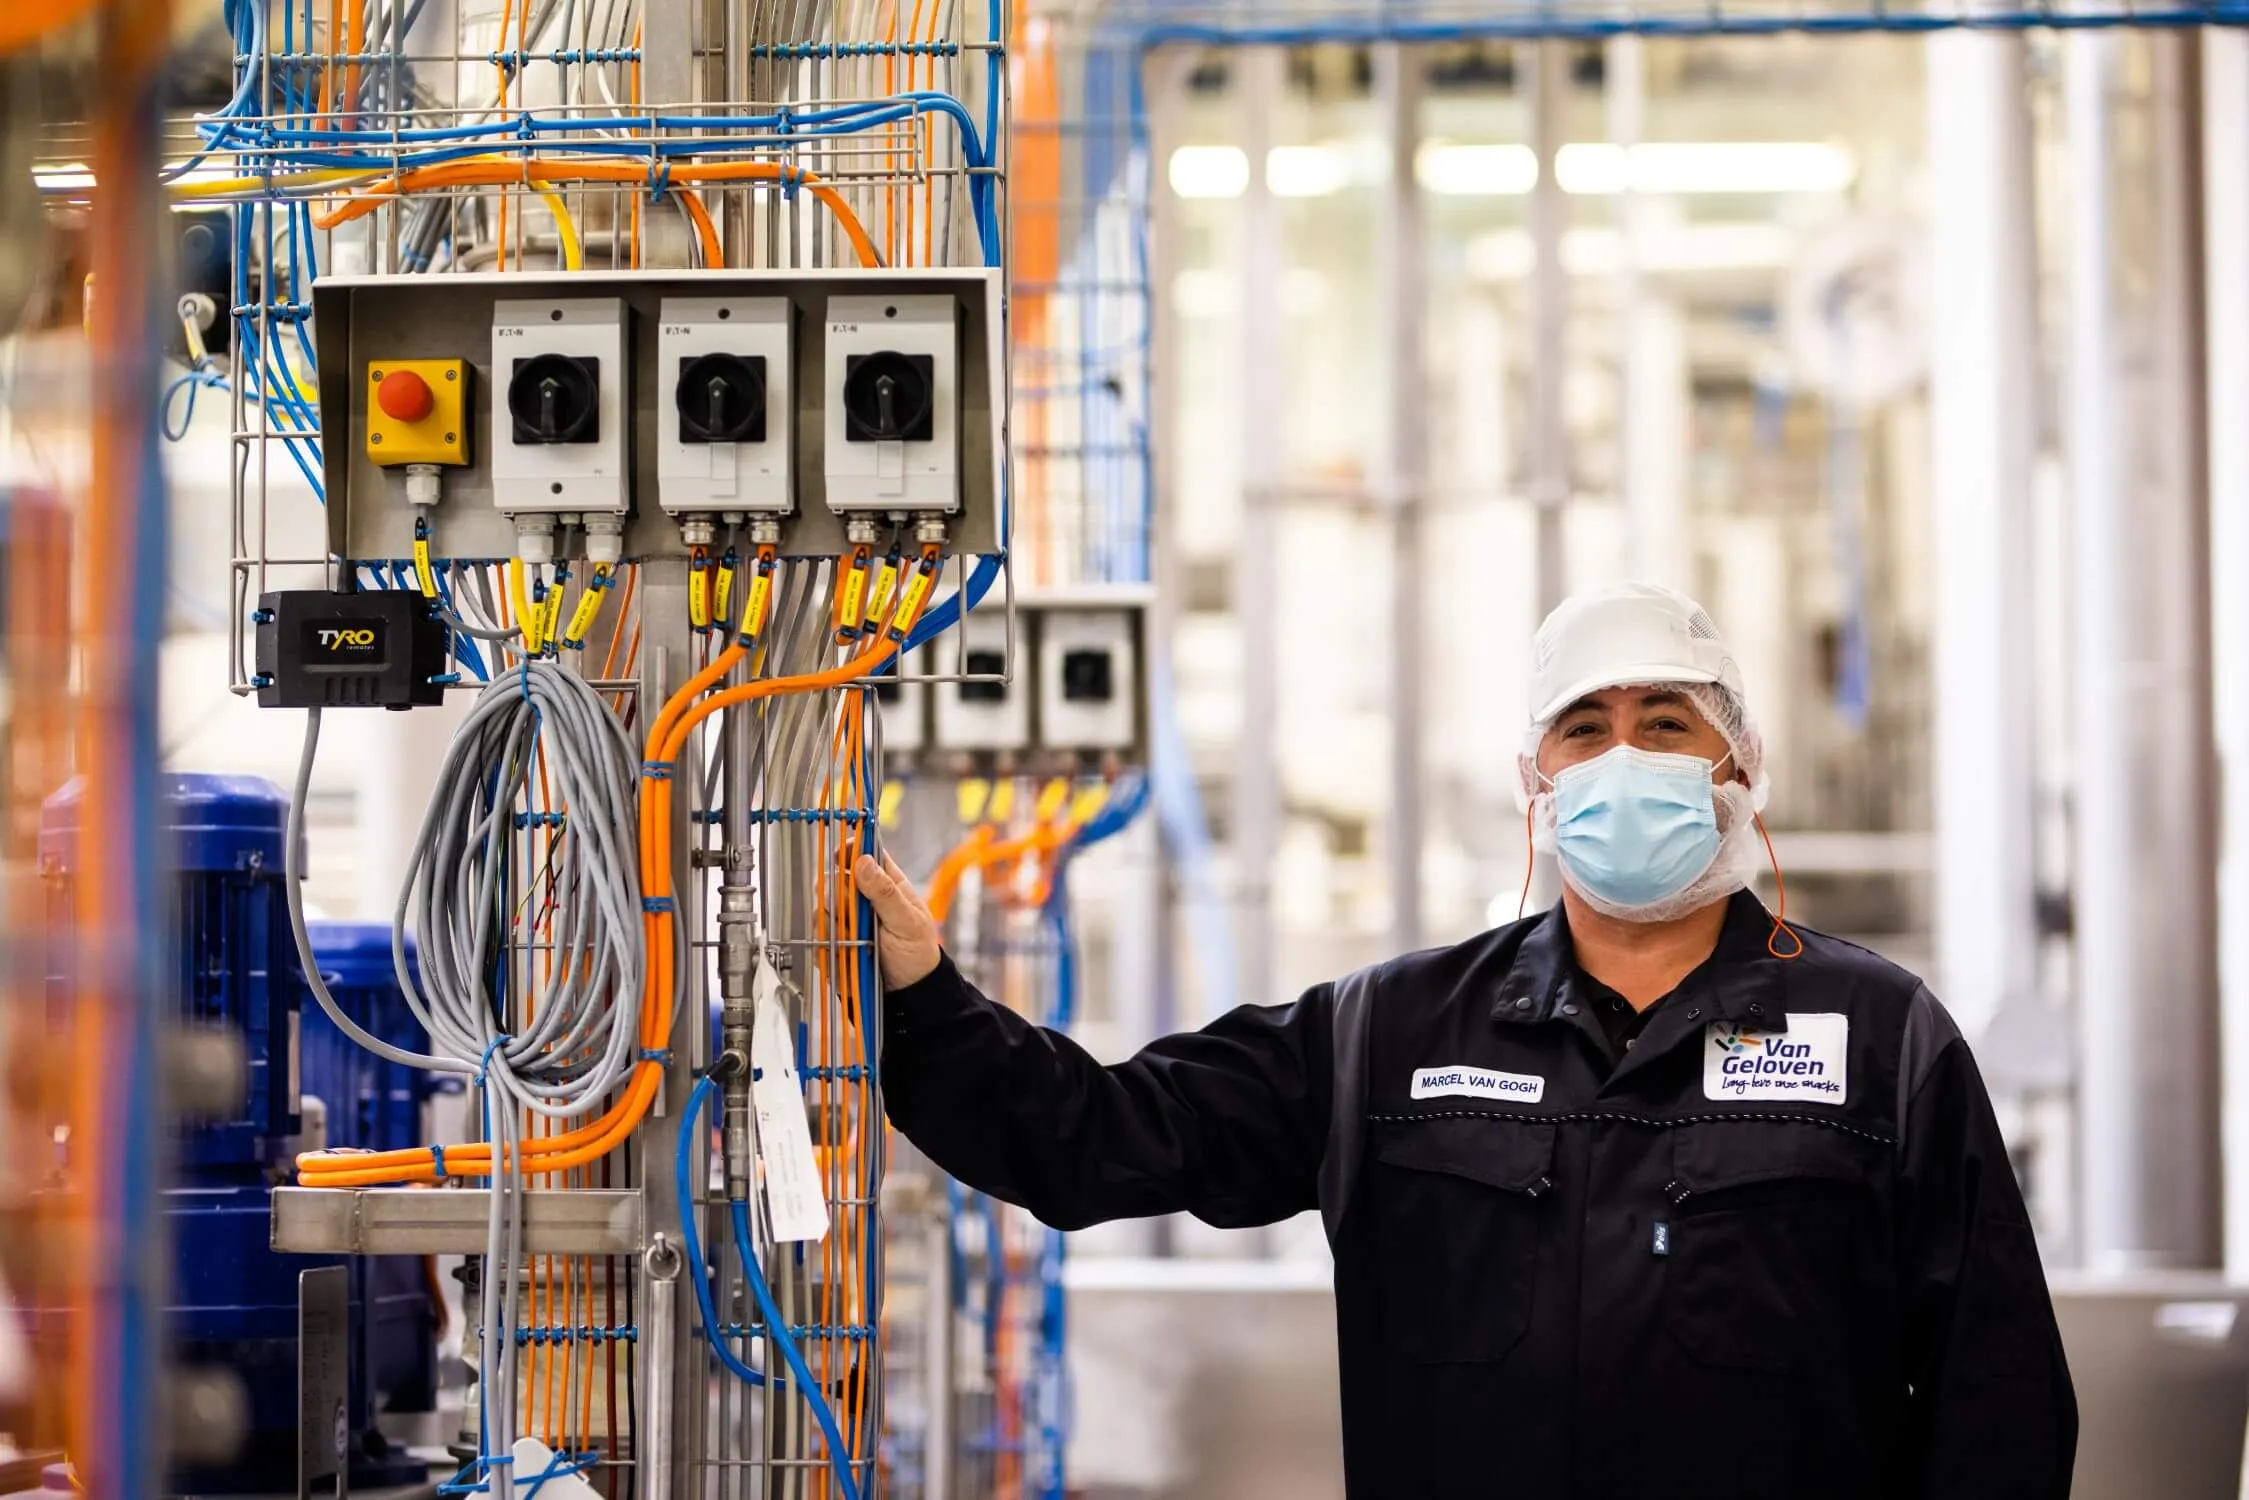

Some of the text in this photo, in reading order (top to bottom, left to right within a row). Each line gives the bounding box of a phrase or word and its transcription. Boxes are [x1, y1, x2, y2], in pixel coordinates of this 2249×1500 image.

[318, 629, 375, 650] TYRO
[1765, 1038, 1811, 1058] Van
[1722, 1055, 1824, 1075] Geloven
[1421, 1073, 1538, 1094] MARCEL VAN GOGH
[1801, 1079, 1841, 1093] snacks
